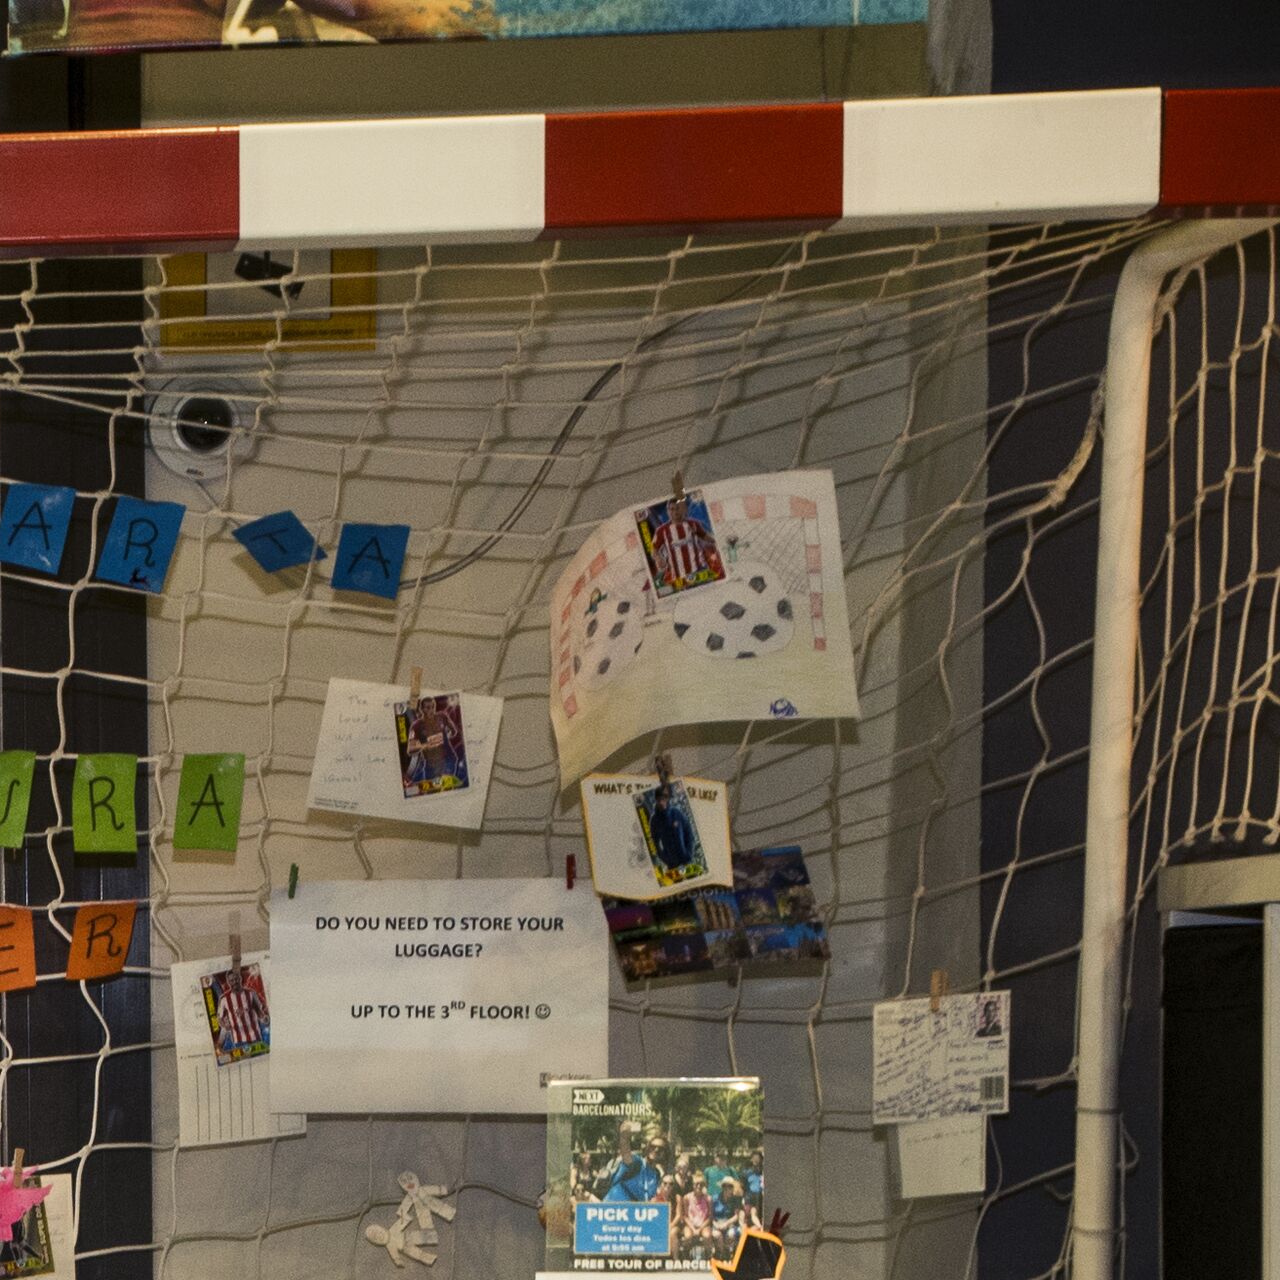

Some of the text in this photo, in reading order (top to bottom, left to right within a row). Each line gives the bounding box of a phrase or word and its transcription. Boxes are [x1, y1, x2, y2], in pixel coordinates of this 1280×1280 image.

[316, 916, 565, 931] DO YOU NEED TO STORE YOUR
[394, 943, 483, 959] LUGGAGE?
[351, 1004, 373, 1018] UP
[378, 1004, 400, 1018] TO
[405, 1005, 436, 1018] THE
[470, 1004, 530, 1019] FLOOR!
[578, 1091, 600, 1102] NEXT
[586, 1207, 660, 1222] PICK UP
[602, 1224, 642, 1234] Every day
[574, 1259, 662, 1270] FREE TOUR OF
